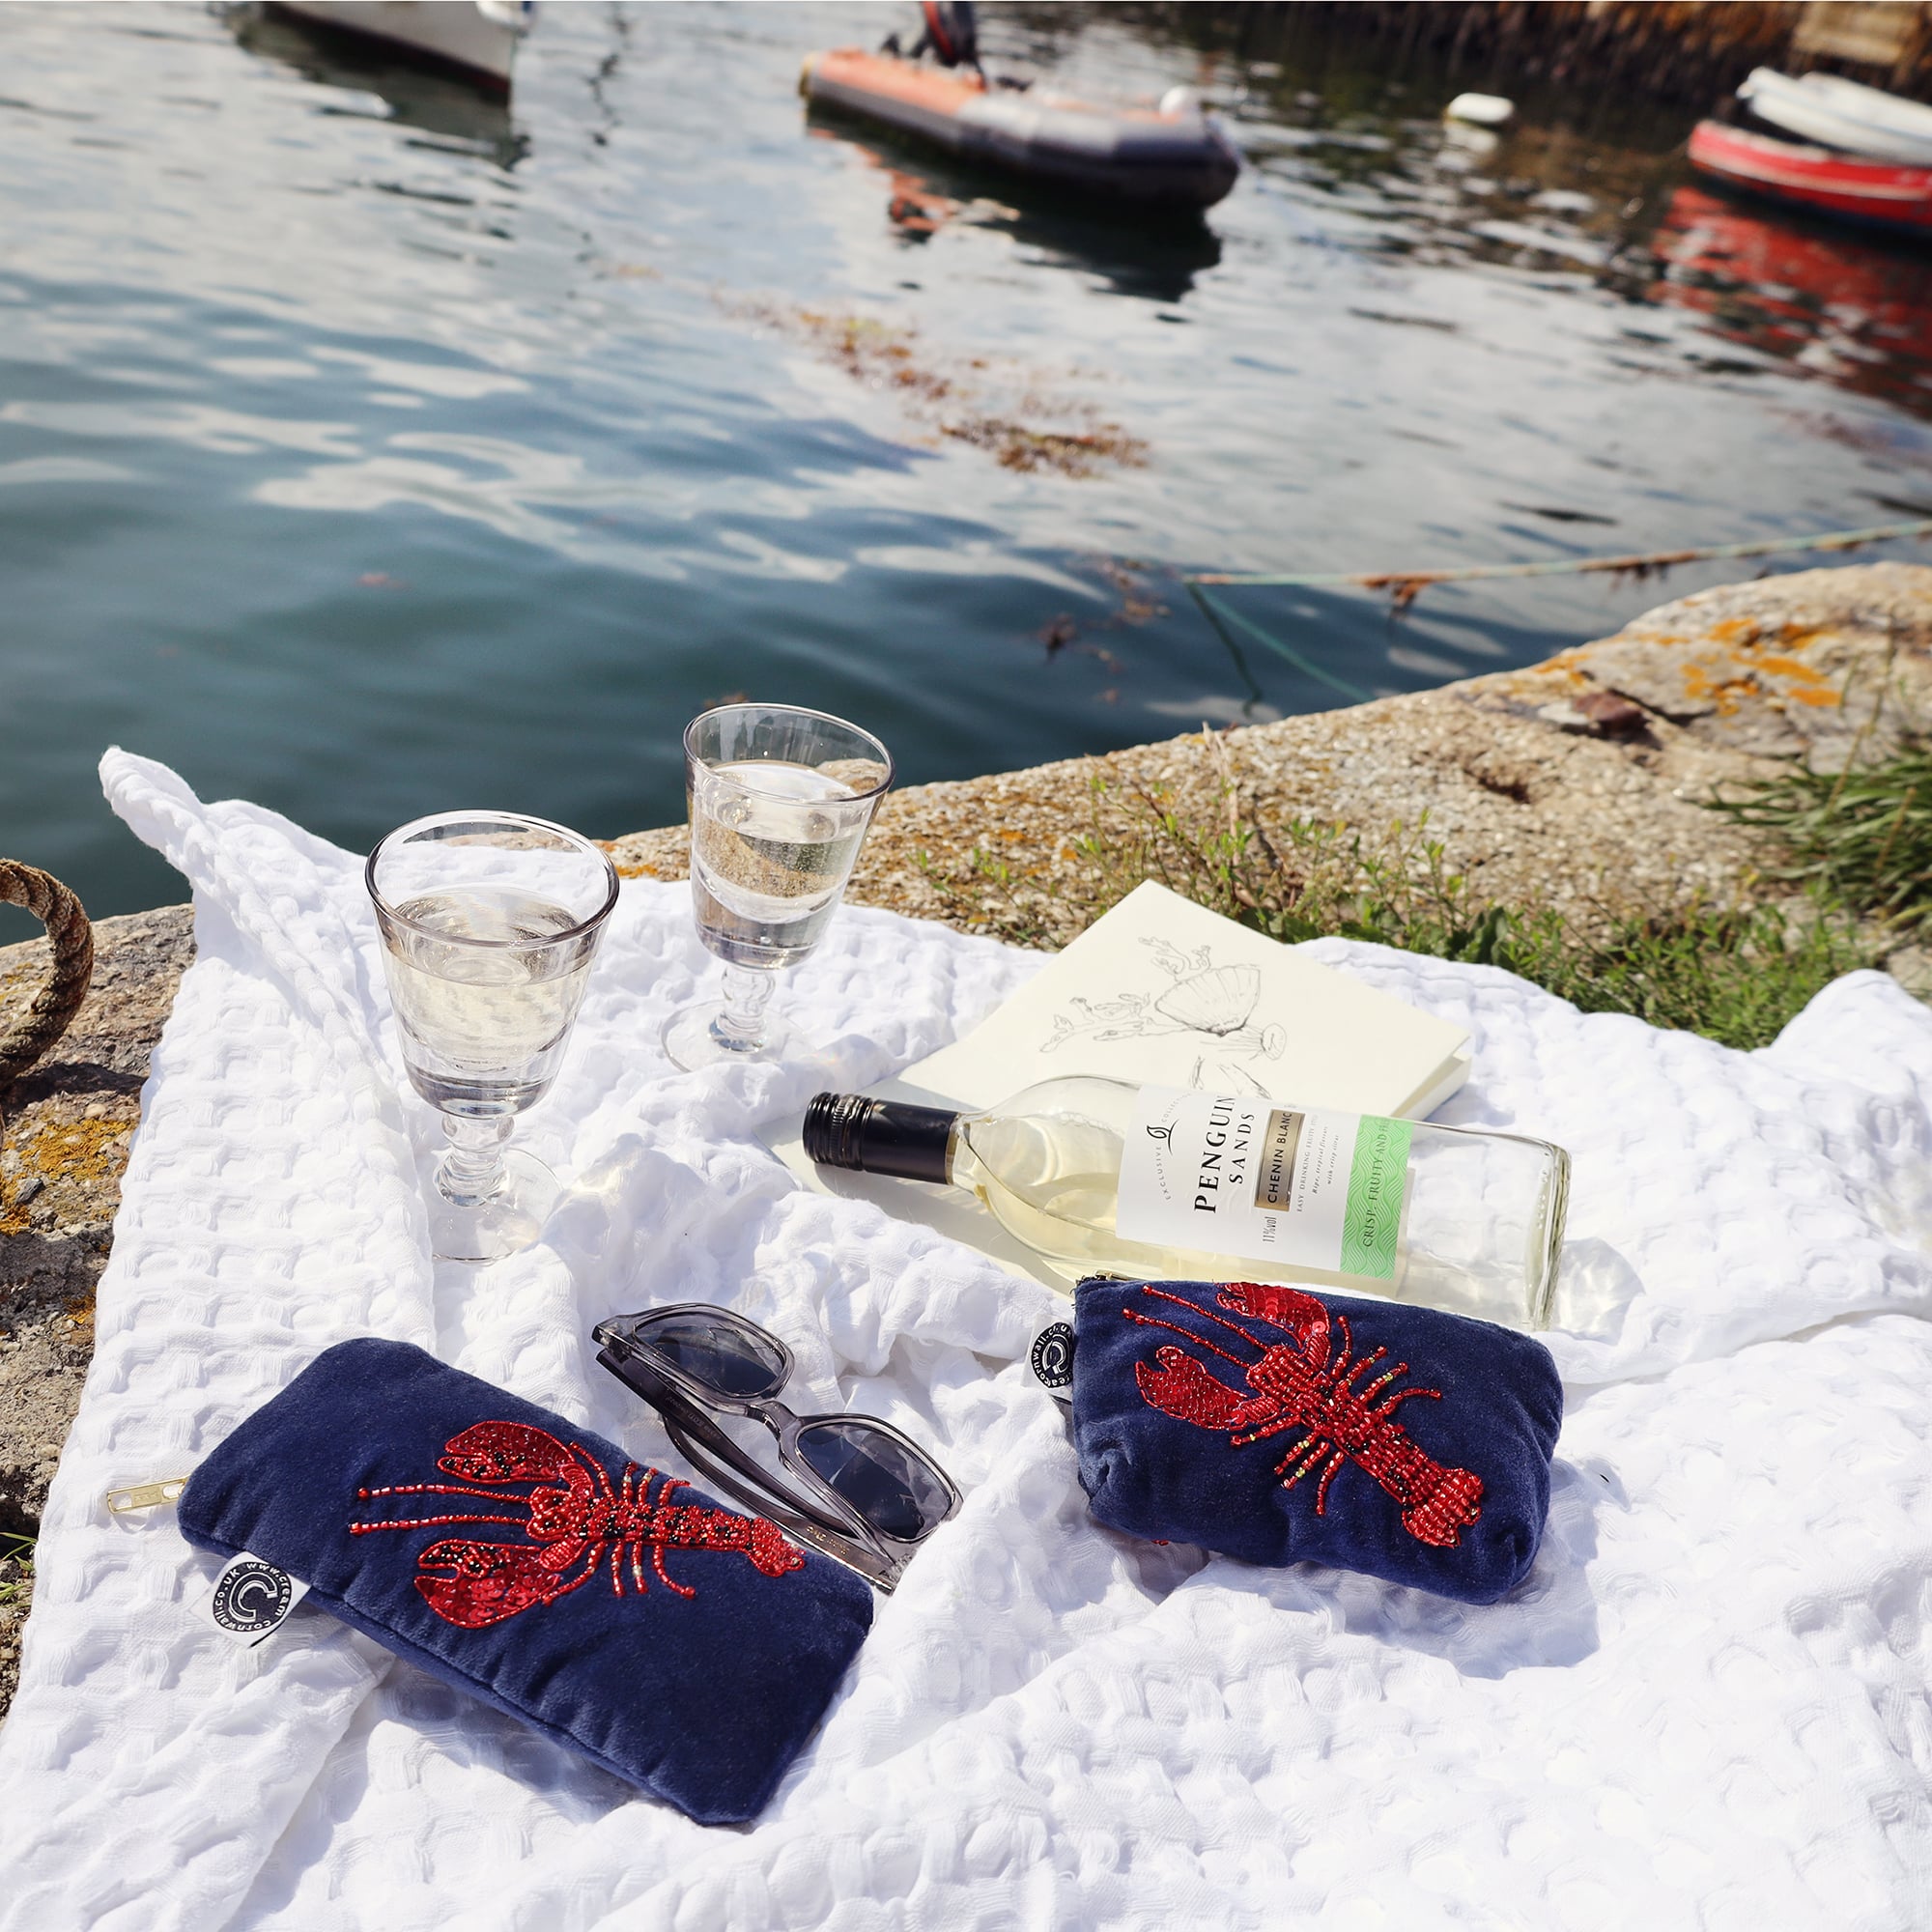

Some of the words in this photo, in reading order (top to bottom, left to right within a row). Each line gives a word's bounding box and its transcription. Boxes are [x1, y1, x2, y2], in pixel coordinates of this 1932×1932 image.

[1194, 1095, 1236, 1213] PENGUIN
[1229, 1113, 1255, 1184] SANDS
[1267, 1149, 1284, 1204] CHENIN
[1276, 1113, 1293, 1145] BLANC
[1299, 1152, 1311, 1191] DRINKING
[1375, 1134, 1387, 1156] AND
[1155, 1147, 1172, 1201] EXCLUSIVE
[1368, 1158, 1383, 1201] FRUITY
